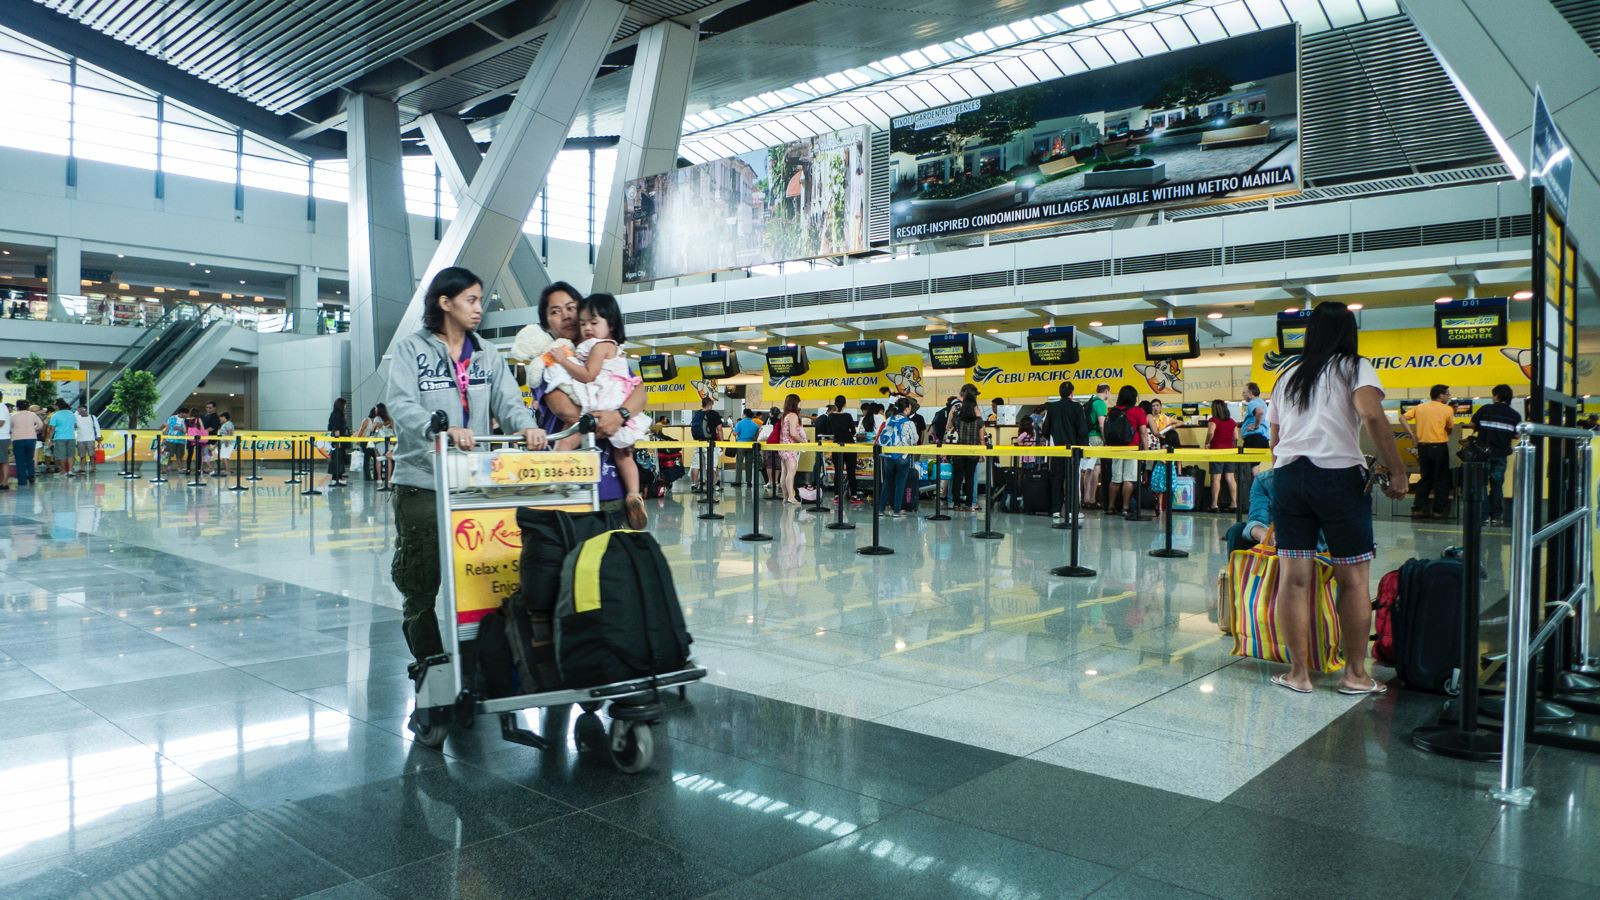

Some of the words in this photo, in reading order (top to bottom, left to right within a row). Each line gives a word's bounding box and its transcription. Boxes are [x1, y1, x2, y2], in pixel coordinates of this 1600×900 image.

[893, 114, 913, 128] TIVOLI
[914, 110, 940, 123] GARDEN
[941, 100, 980, 116] RESIDENCES
[896, 217, 970, 238] RESORT-INSPIRED
[971, 207, 1041, 228] CONDOMINIUM
[1042, 199, 1090, 217] VILLAGES
[1092, 190, 1150, 210] AVAILABLE
[1151, 183, 1194, 201] WITHIN
[1197, 177, 1239, 195] METRO
[1242, 168, 1292, 188] MANILA
[1405, 352, 1483, 368] AIR.COM
[785, 378, 807, 389] CEBU
[808, 376, 839, 388] PACIFIC
[840, 375, 879, 387] AIR.COM
[996, 372, 1025, 383] CEBU
[1028, 370, 1071, 382] PACIFIC
[1073, 367, 1123, 380] AIR.COM
[658, 383, 686, 392] AIR.COM
[518, 468, 540, 481] (02)
[544, 467, 594, 478] 836-6333
[465, 562, 500, 576] Relax
